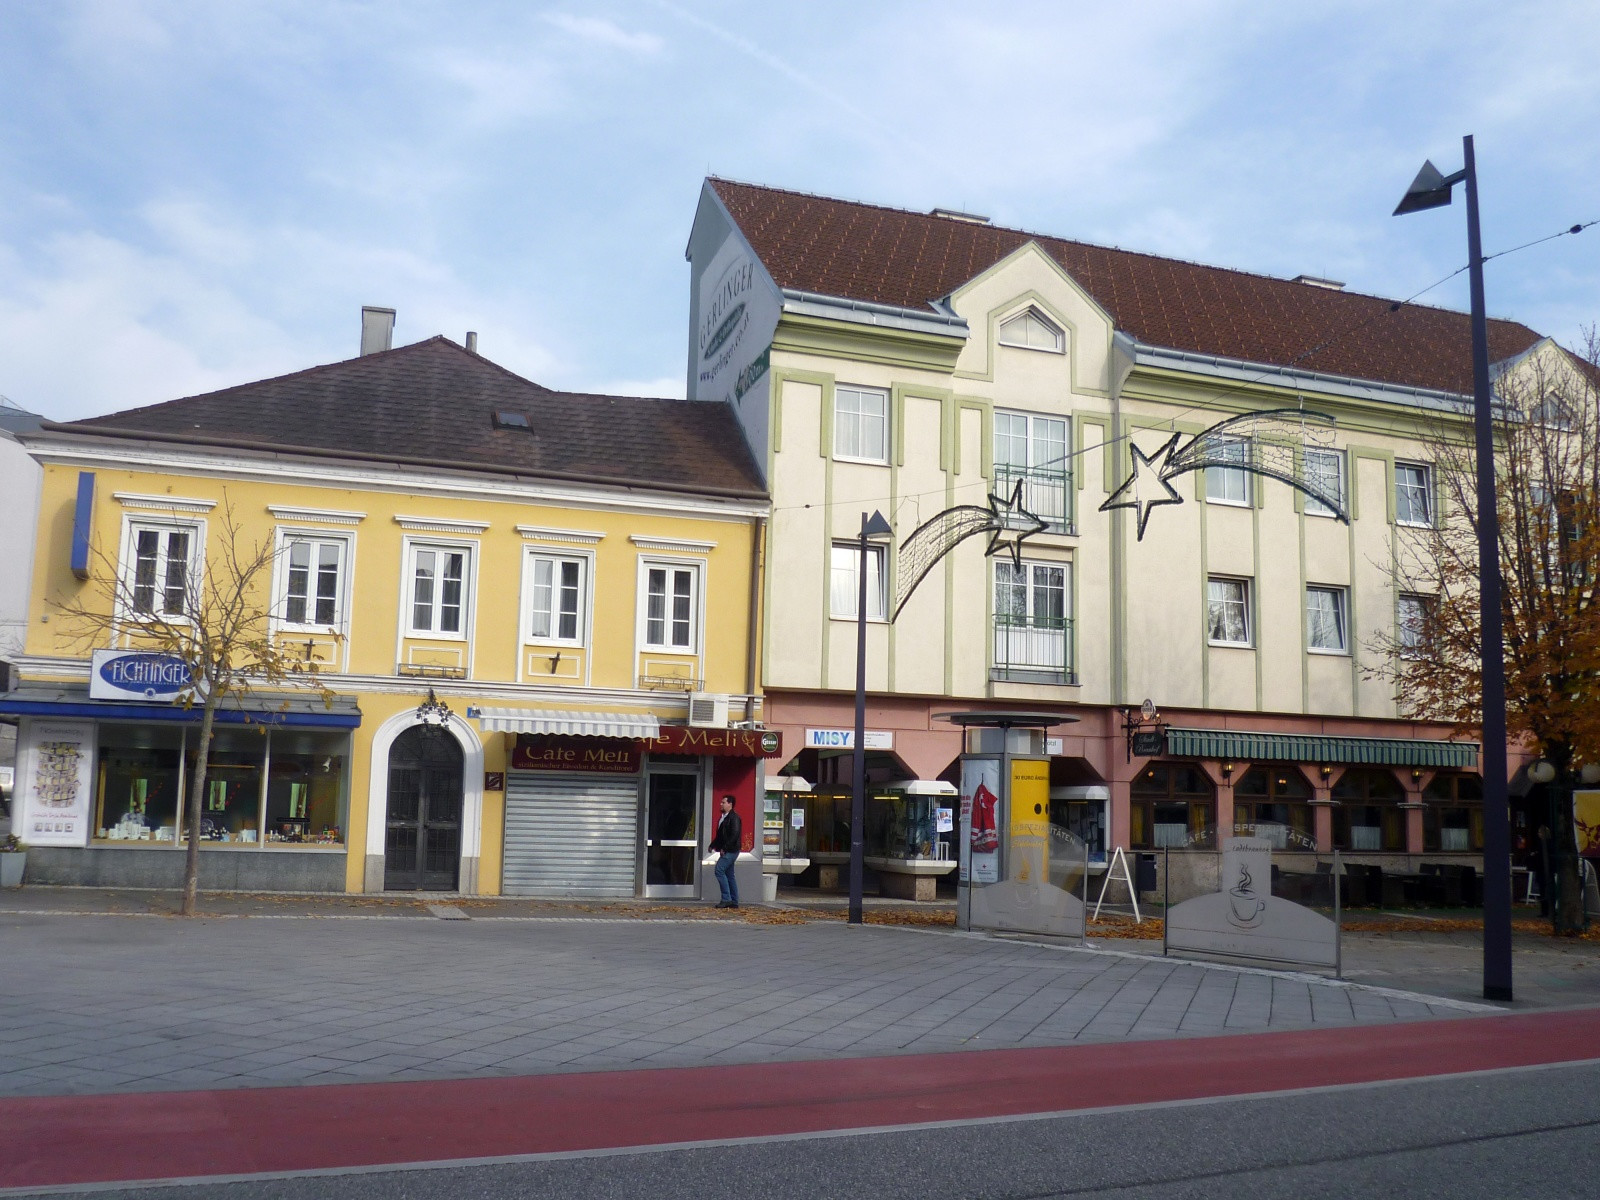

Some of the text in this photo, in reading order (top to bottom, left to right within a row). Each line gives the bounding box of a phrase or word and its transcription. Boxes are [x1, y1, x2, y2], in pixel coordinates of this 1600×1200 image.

[700, 263, 754, 350] GERLINGER
[112, 660, 191, 684] FICHTINGER
[679, 729, 737, 747] Meli
[813, 731, 850, 745] MISY
[583, 748, 630, 763] Meli
